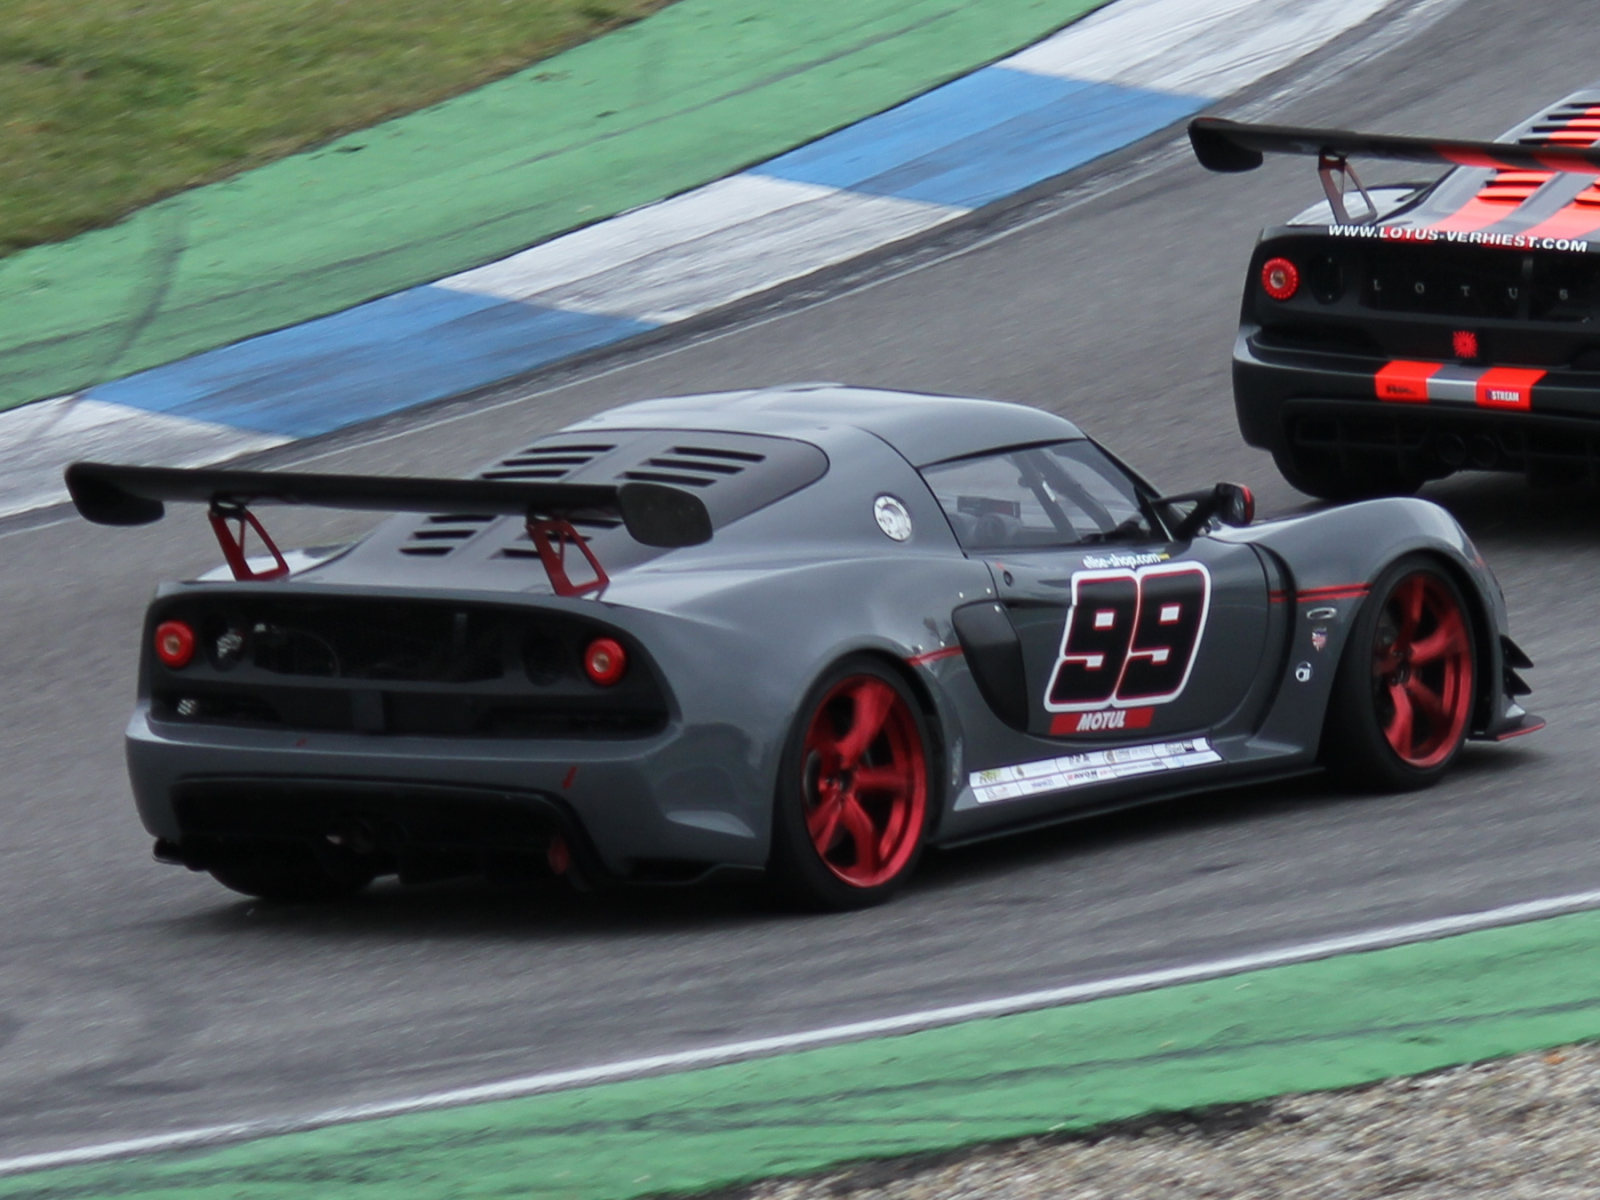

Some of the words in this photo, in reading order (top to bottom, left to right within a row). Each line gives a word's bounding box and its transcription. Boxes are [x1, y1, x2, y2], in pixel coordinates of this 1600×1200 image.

[1328, 224, 1588, 253] WWW.LOTUS-VERHIEST.COM
[1082, 553, 1161, 569] elise-shop.com
[1044, 561, 1211, 712] 99
[1076, 710, 1126, 731] MOTUL
